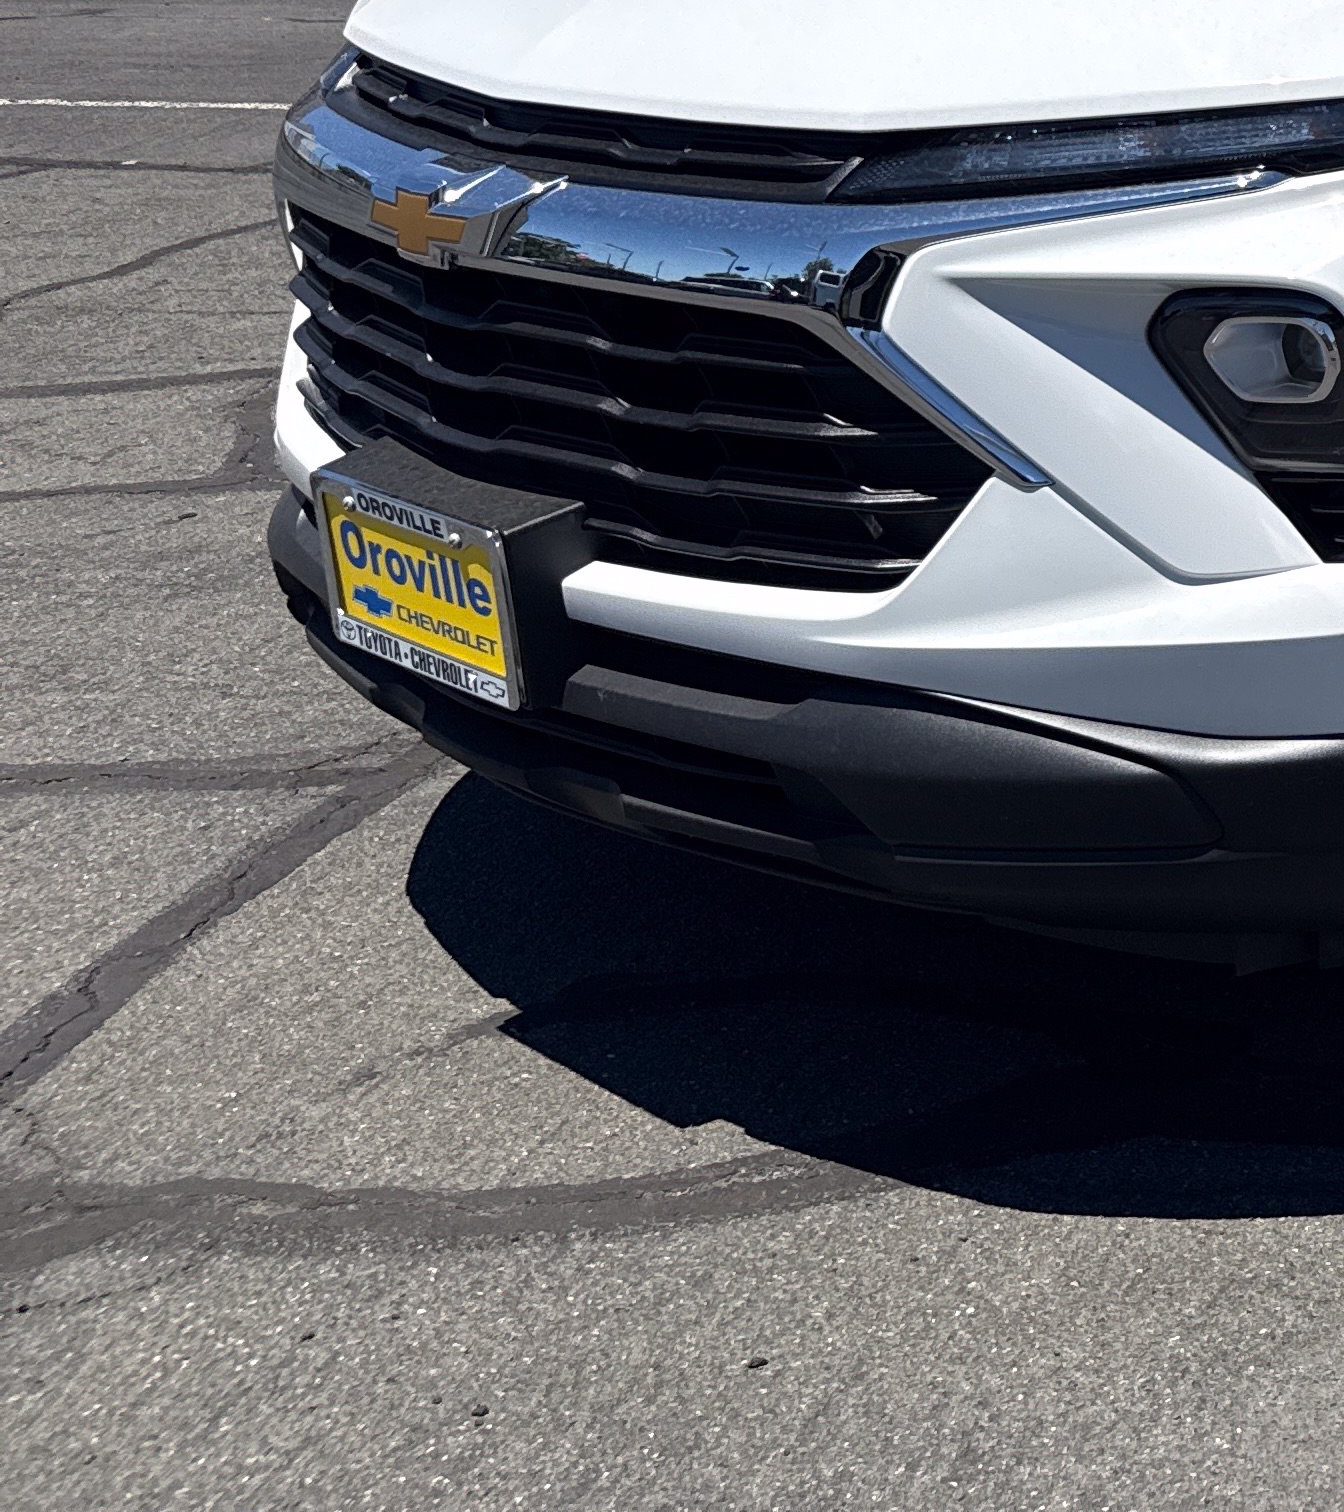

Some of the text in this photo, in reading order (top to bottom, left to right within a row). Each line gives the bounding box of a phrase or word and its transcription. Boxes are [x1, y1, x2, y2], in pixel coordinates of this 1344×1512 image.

[356, 493, 444, 539] OROVILLE
[340, 519, 492, 617] Oroville
[356, 624, 478, 693] TOYOTA CHEVROLET
[397, 604, 498, 656] CHEVROLET
